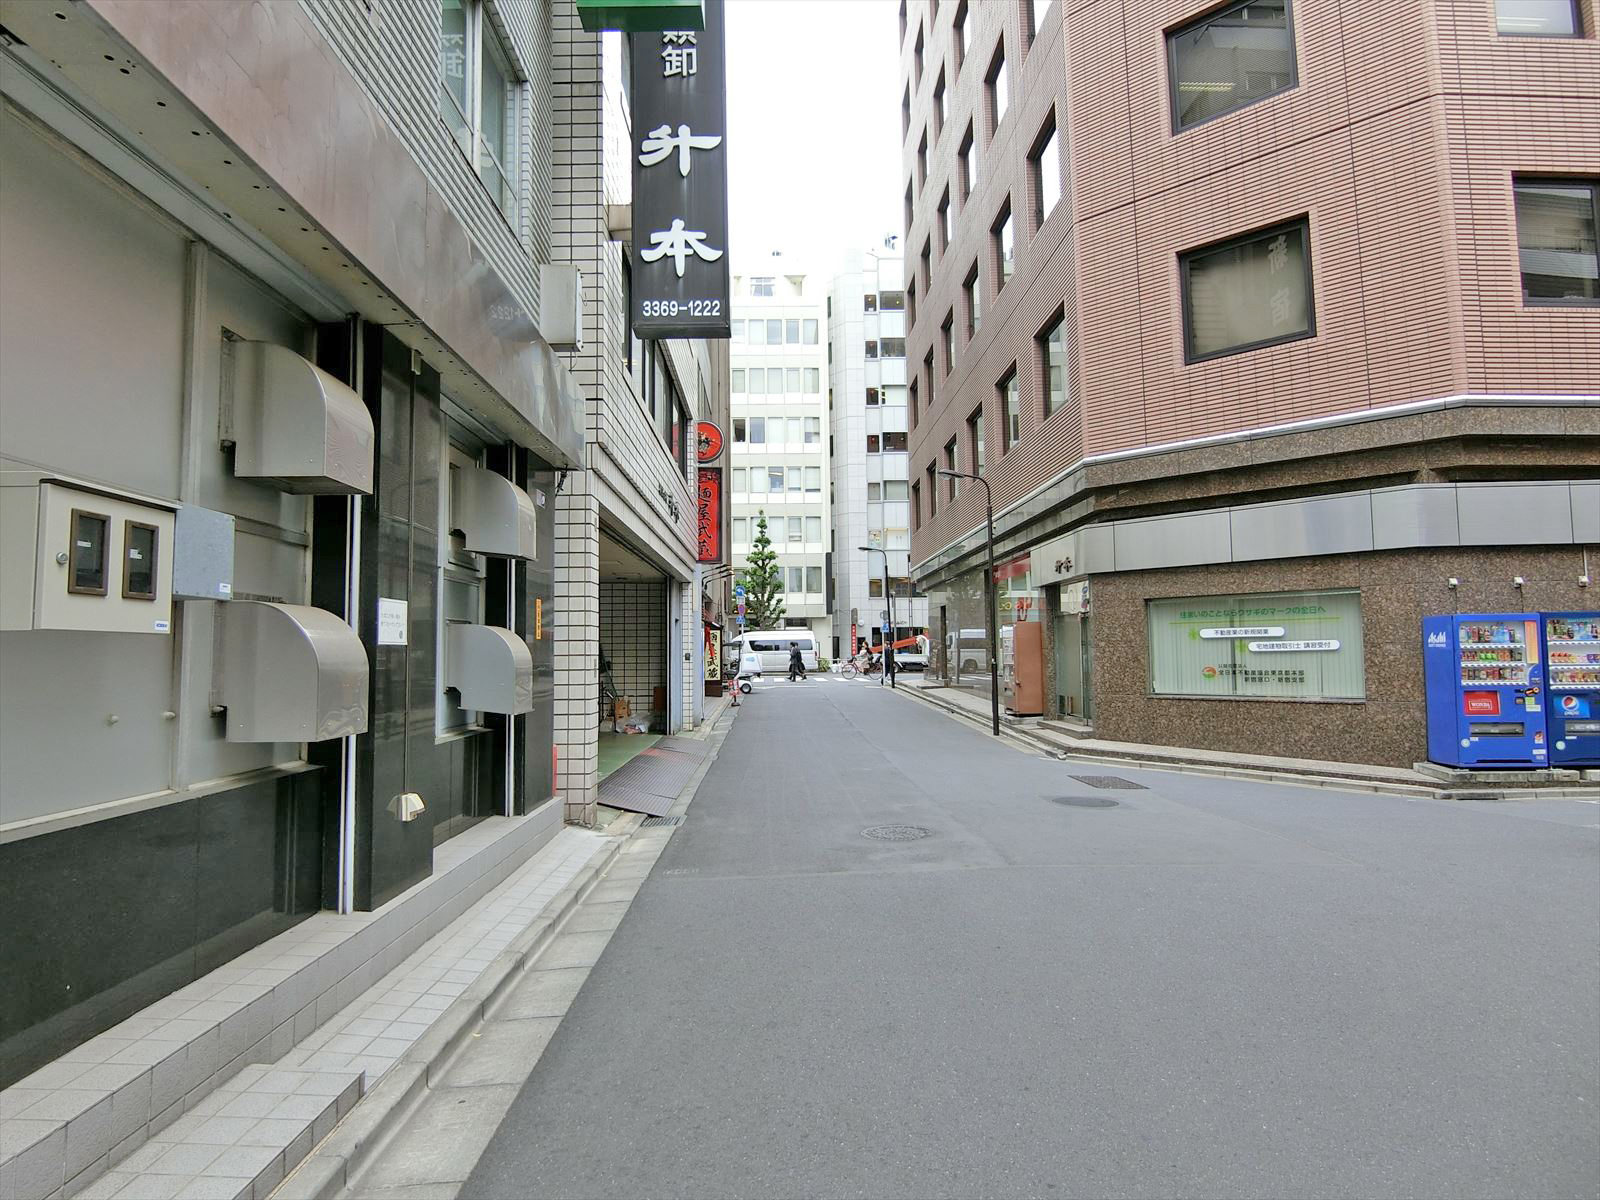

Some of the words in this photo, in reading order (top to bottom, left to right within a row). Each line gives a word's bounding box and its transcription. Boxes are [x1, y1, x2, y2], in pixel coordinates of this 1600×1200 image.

[638, 124, 724, 278] 升本
[642, 299, 721, 318] 3369-1222
[1214, 628, 1269, 636] 不動産業の新規開業
